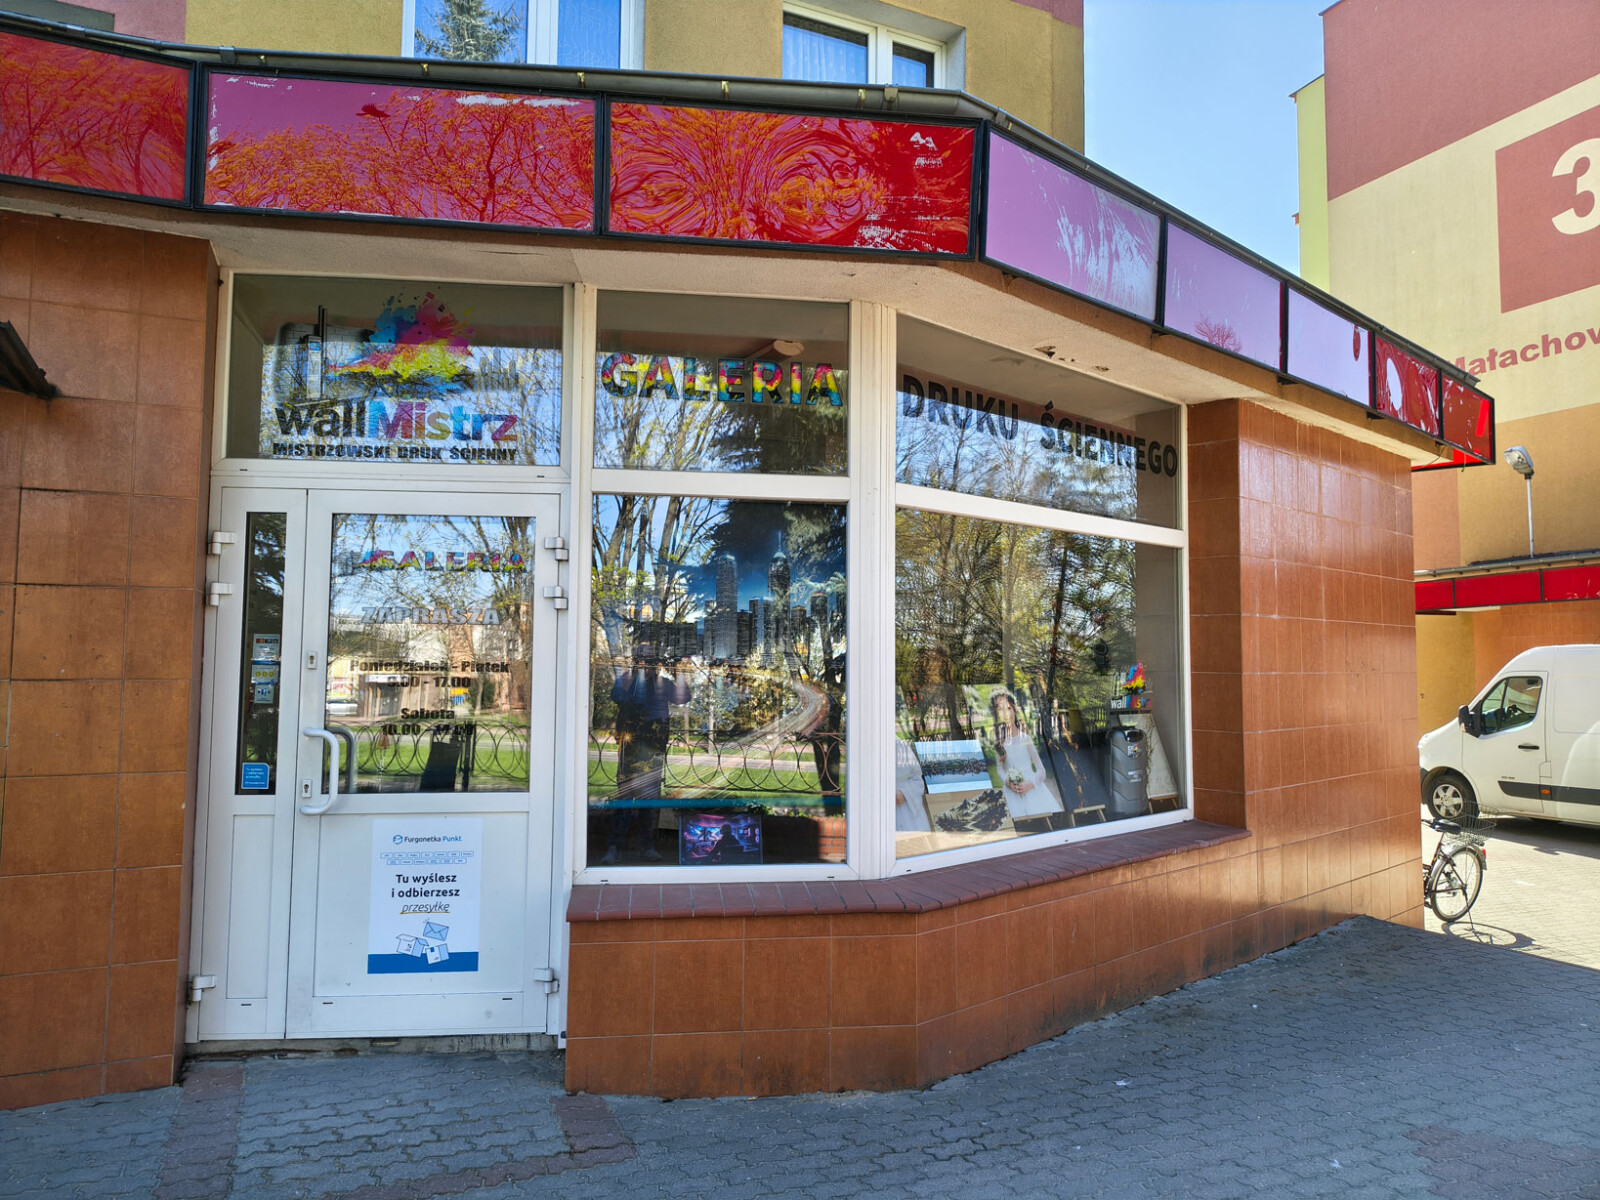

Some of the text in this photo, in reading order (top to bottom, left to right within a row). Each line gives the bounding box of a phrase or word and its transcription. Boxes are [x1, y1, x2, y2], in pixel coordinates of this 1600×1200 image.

[1551, 137, 1600, 235] 3
[600, 351, 843, 408] GALERIA
[274, 398, 518, 442] wallMistrz
[902, 373, 1177, 478] DRUKU ŚCIENNEGO
[273, 443, 517, 461] MISTRZOWSKI DRUK ŚCIENNY
[376, 550, 527, 573] GALERIA
[361, 606, 500, 625] ZAPRASZA
[433, 676, 472, 688] 17.00
[401, 707, 455, 720] Sobota
[404, 836, 441, 844] Furgonetka
[395, 873, 457, 886] Tu wyślesz
[391, 887, 460, 898] i odbierzesz
[401, 901, 450, 913] przesyłkę
